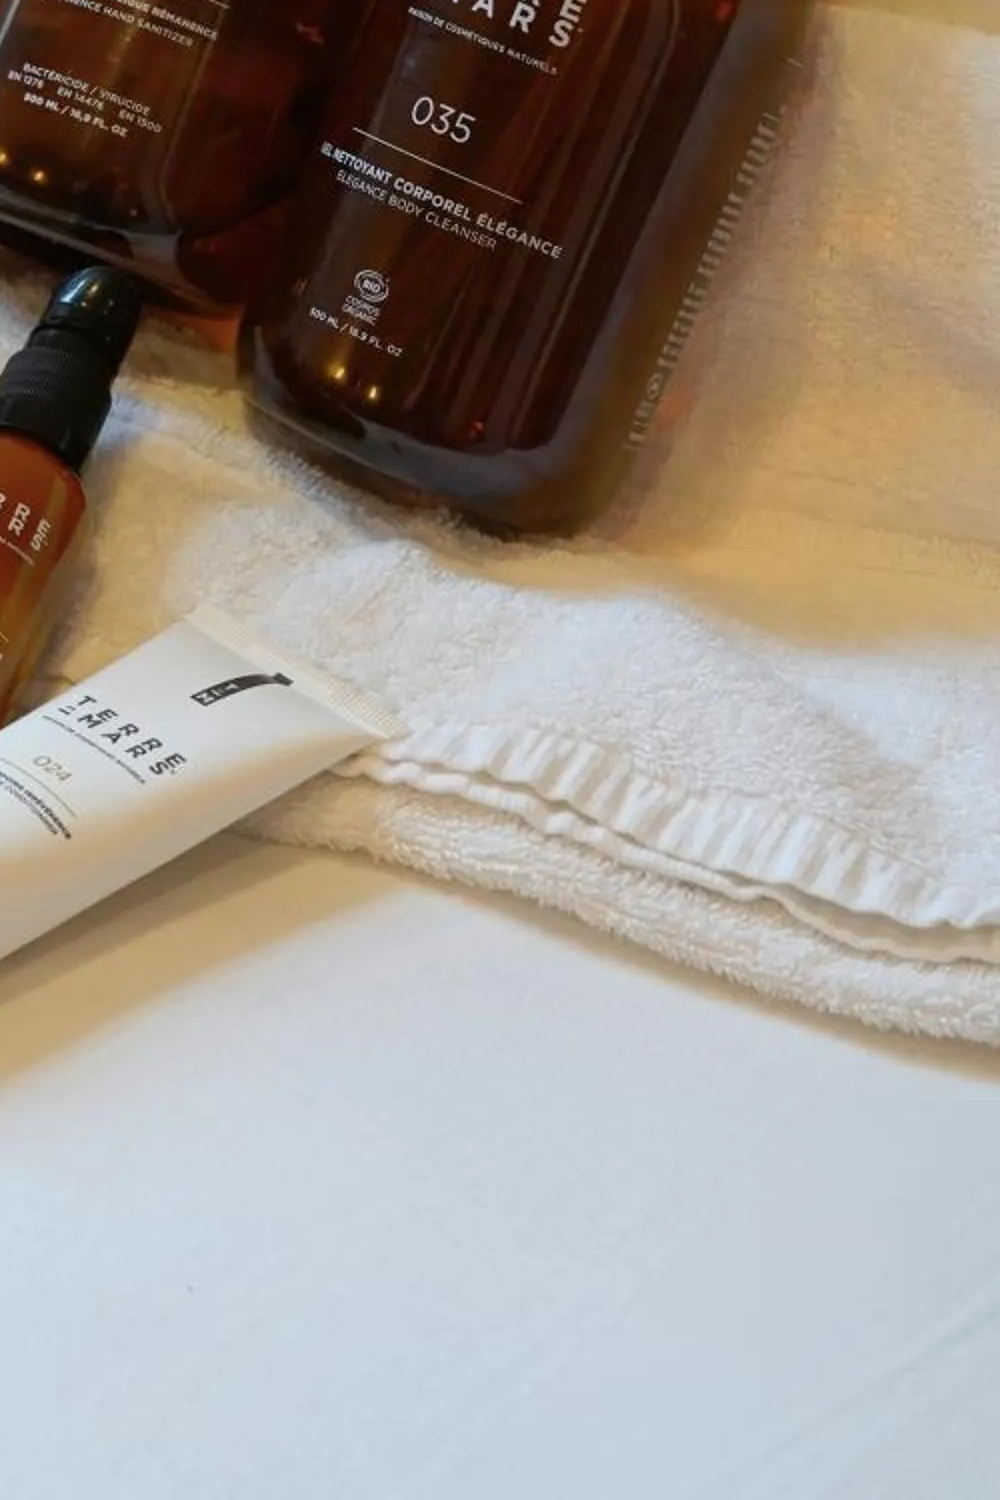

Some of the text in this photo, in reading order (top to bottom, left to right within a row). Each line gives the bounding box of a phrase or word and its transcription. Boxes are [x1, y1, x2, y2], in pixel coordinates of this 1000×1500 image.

[103, 5, 136, 25] HAND
[137, 15, 194, 48] SANITIZER
[433, 16, 445, 30] DE
[7, 69, 22, 82] EN
[56, 86, 72, 98] EN
[118, 108, 135, 120] EN
[410, 96, 477, 144] 035
[332, 147, 393, 185] NETTOYANT
[393, 177, 473, 222] CORPOREL
[475, 211, 564, 260] ÉLÉGANCE
[387, 193, 425, 219] BODY
[425, 210, 499, 252] CLEANSER
[76, 713, 170, 776] MARS
[77, 695, 187, 769] TERRE
[32, 755, 73, 781] 024
